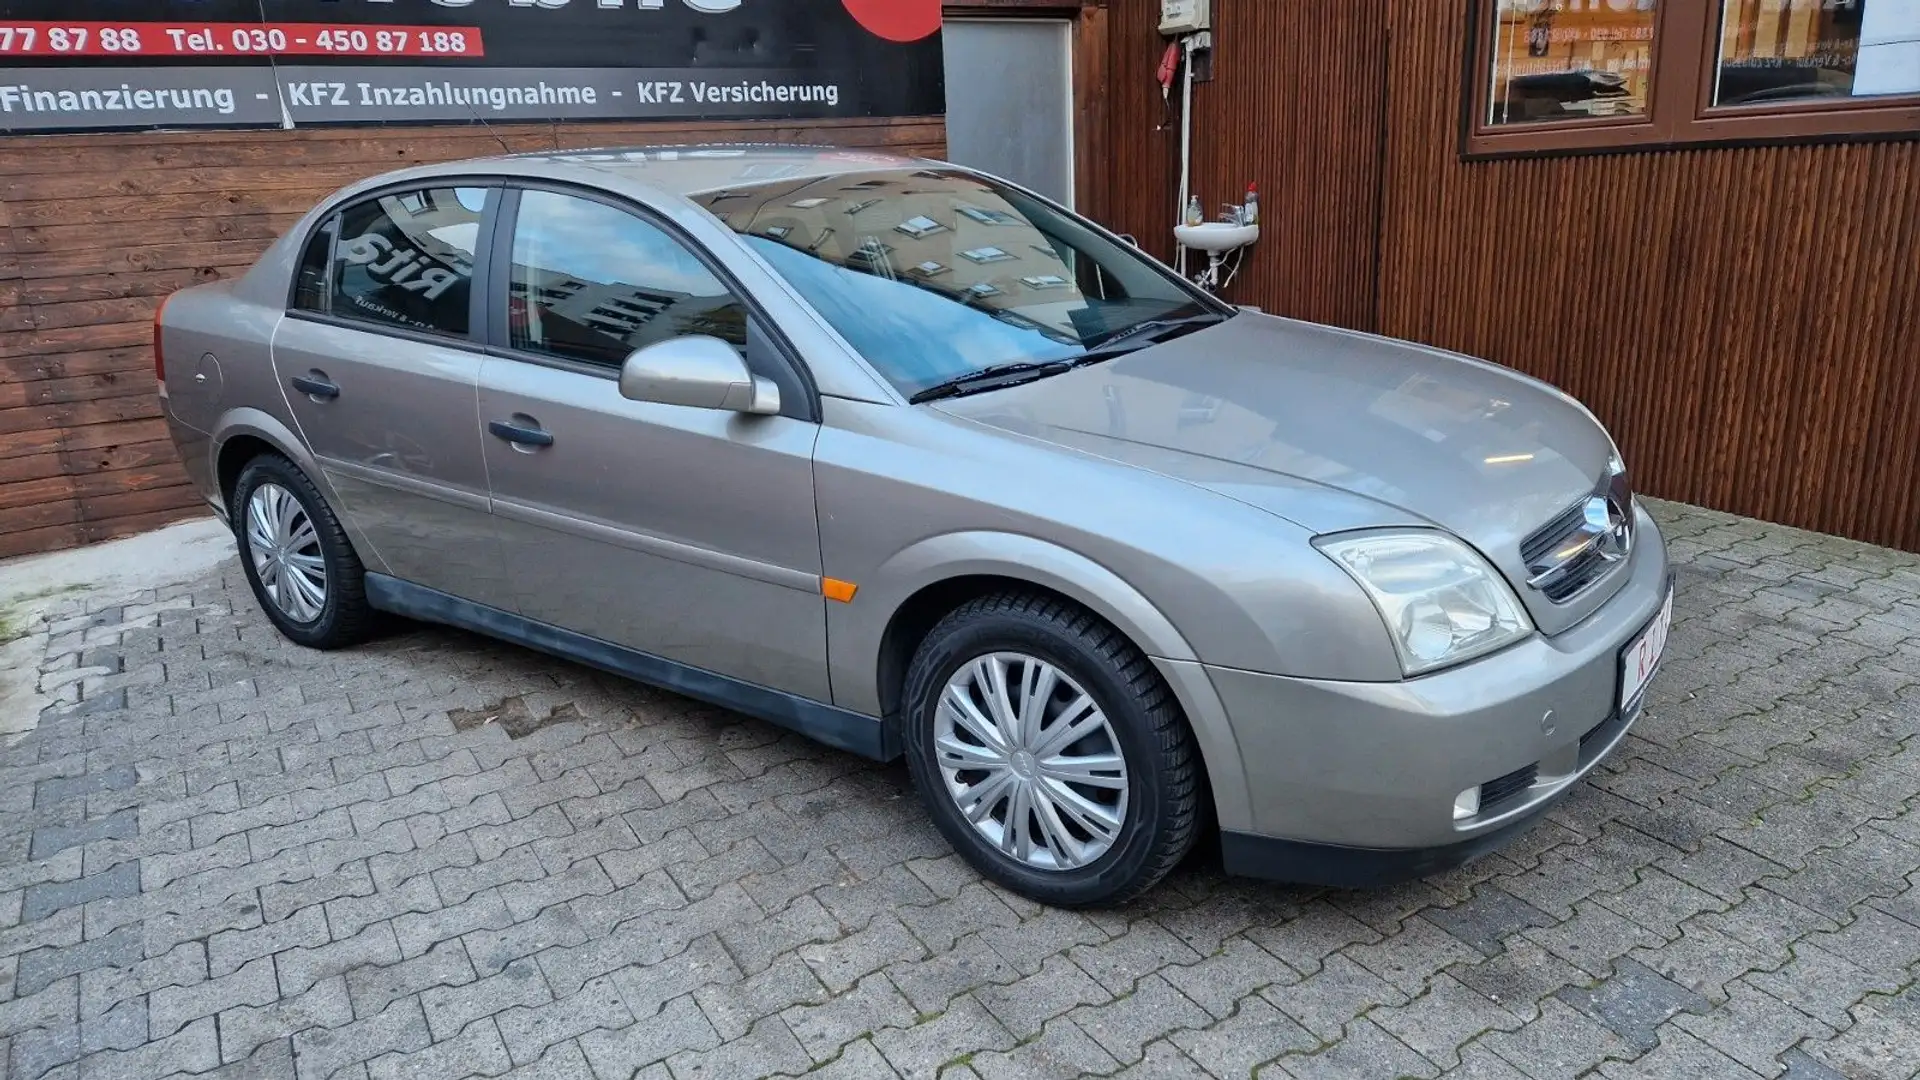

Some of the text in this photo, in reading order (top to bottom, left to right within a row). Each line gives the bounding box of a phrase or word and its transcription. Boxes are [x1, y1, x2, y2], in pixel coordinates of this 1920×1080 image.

[0, 28, 140, 51] 77 87 88
[166, 28, 223, 51] Tel.
[233, 28, 286, 51] 030
[315, 31, 367, 51] 450
[376, 31, 407, 52] 87
[418, 31, 465, 53] 188
[0, 84, 234, 114] Finanzierung
[288, 82, 349, 106] KFZ
[357, 81, 597, 110] Inzahlungnahme
[638, 82, 683, 103] KFZ
[690, 81, 838, 105] Versicherung
